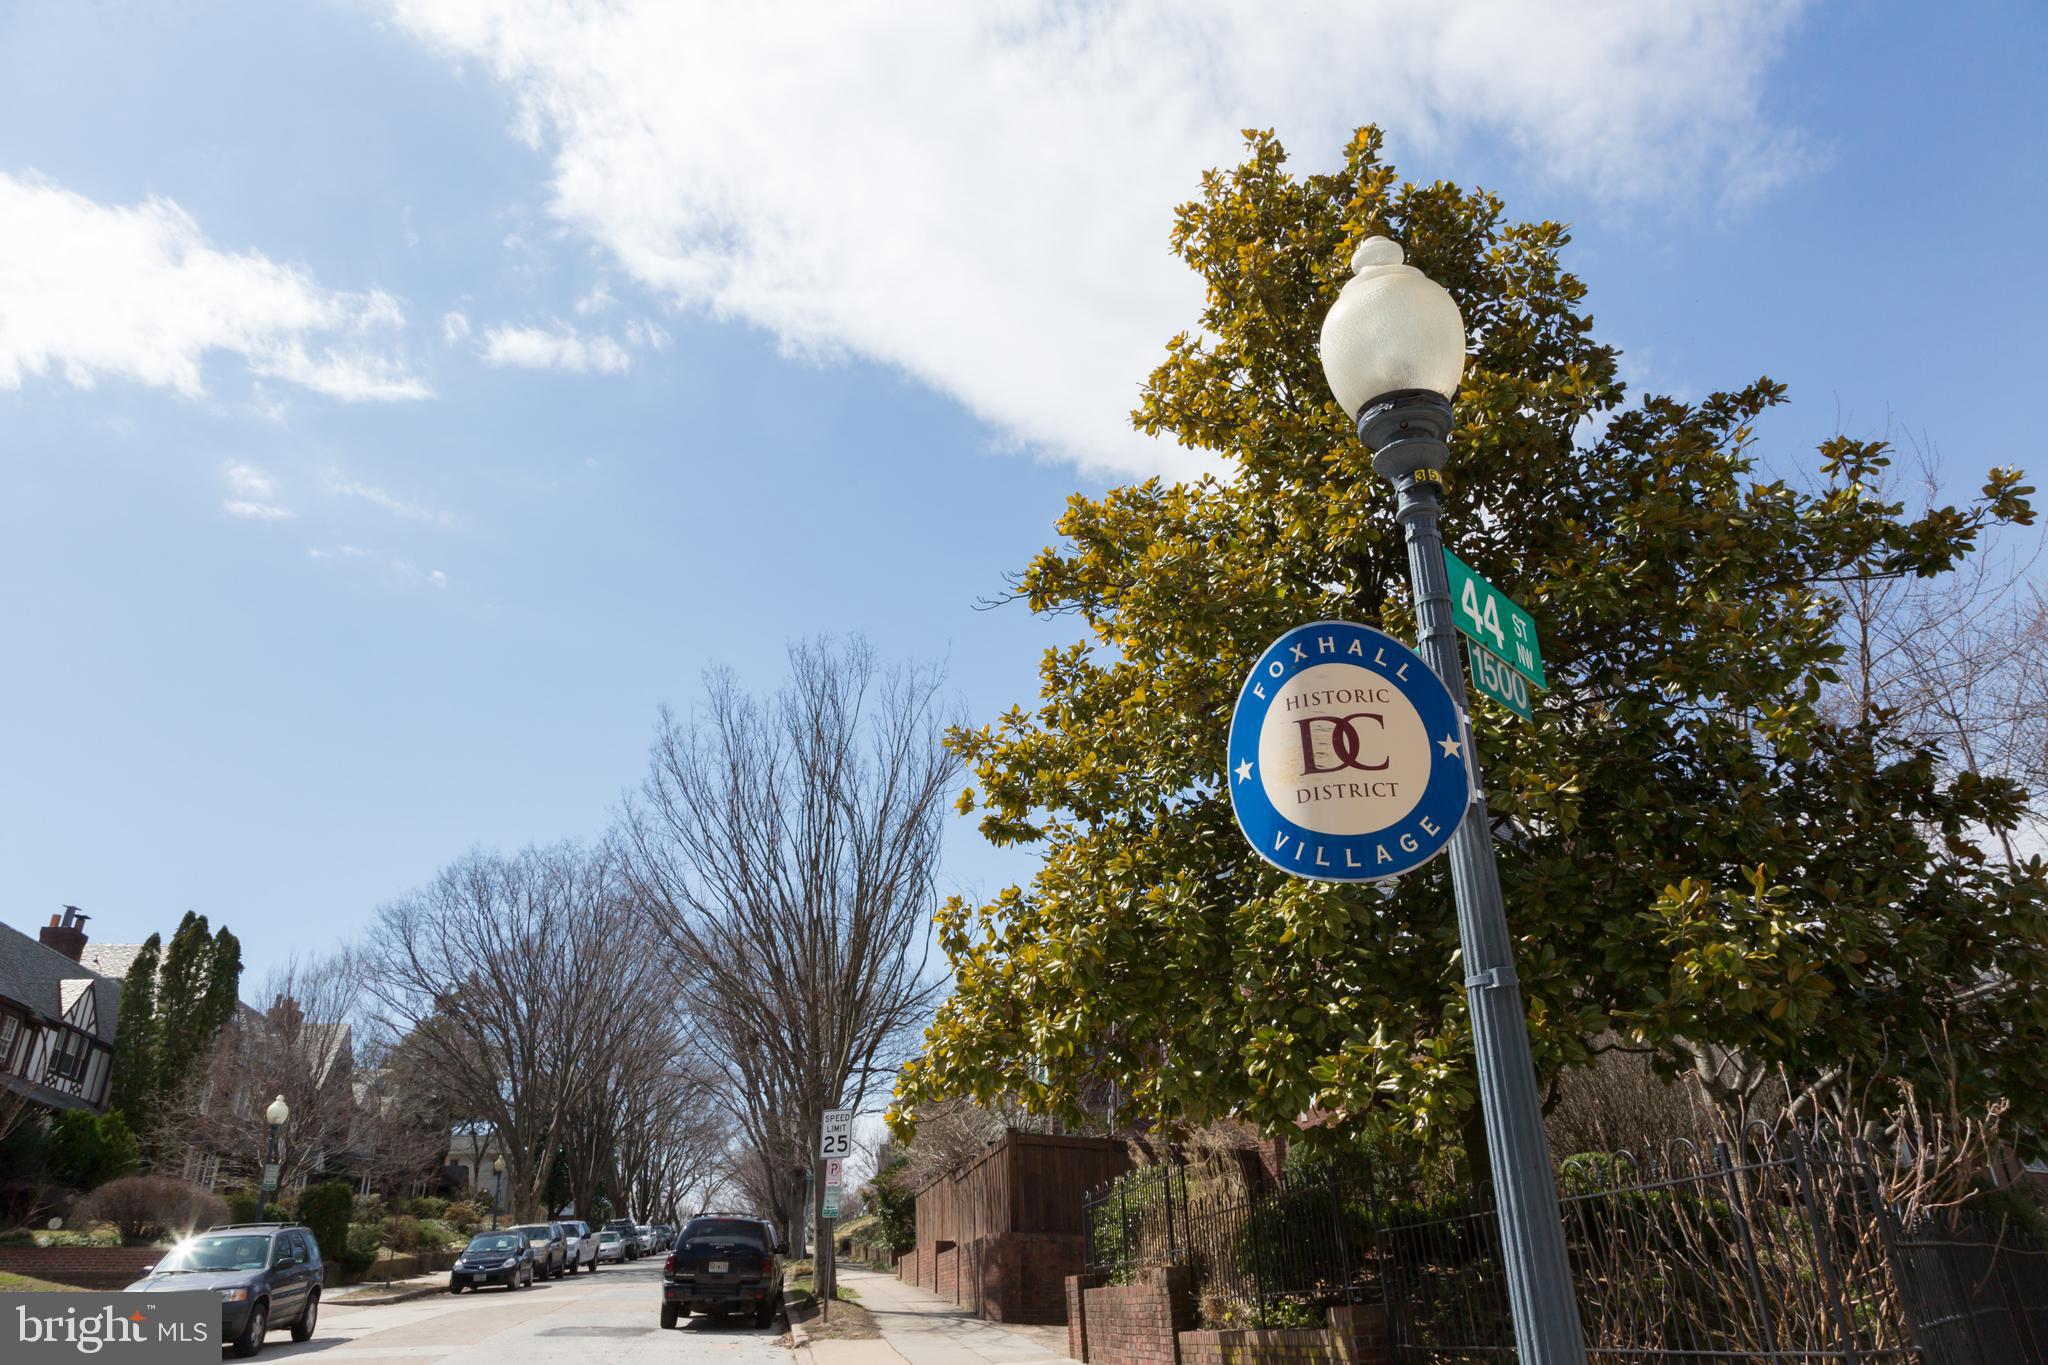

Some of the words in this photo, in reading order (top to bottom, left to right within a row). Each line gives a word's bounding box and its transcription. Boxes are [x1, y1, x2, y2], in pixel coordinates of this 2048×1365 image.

[1461, 577, 1505, 650] 44
[1511, 612, 1527, 642] ST
[1253, 636, 1410, 700] FOXHALL
[1515, 641, 1533, 672] NW
[1473, 644, 1527, 710] 1500
[1286, 688, 1391, 711] HISTORIC
[1292, 712, 1390, 776] DC
[1297, 782, 1400, 804] DISTRICT
[1274, 815, 1441, 868] VILLAGE
[825, 1113, 850, 1123] SPEED
[827, 1124, 847, 1133] LIMIT
[824, 1135, 848, 1153] 25
